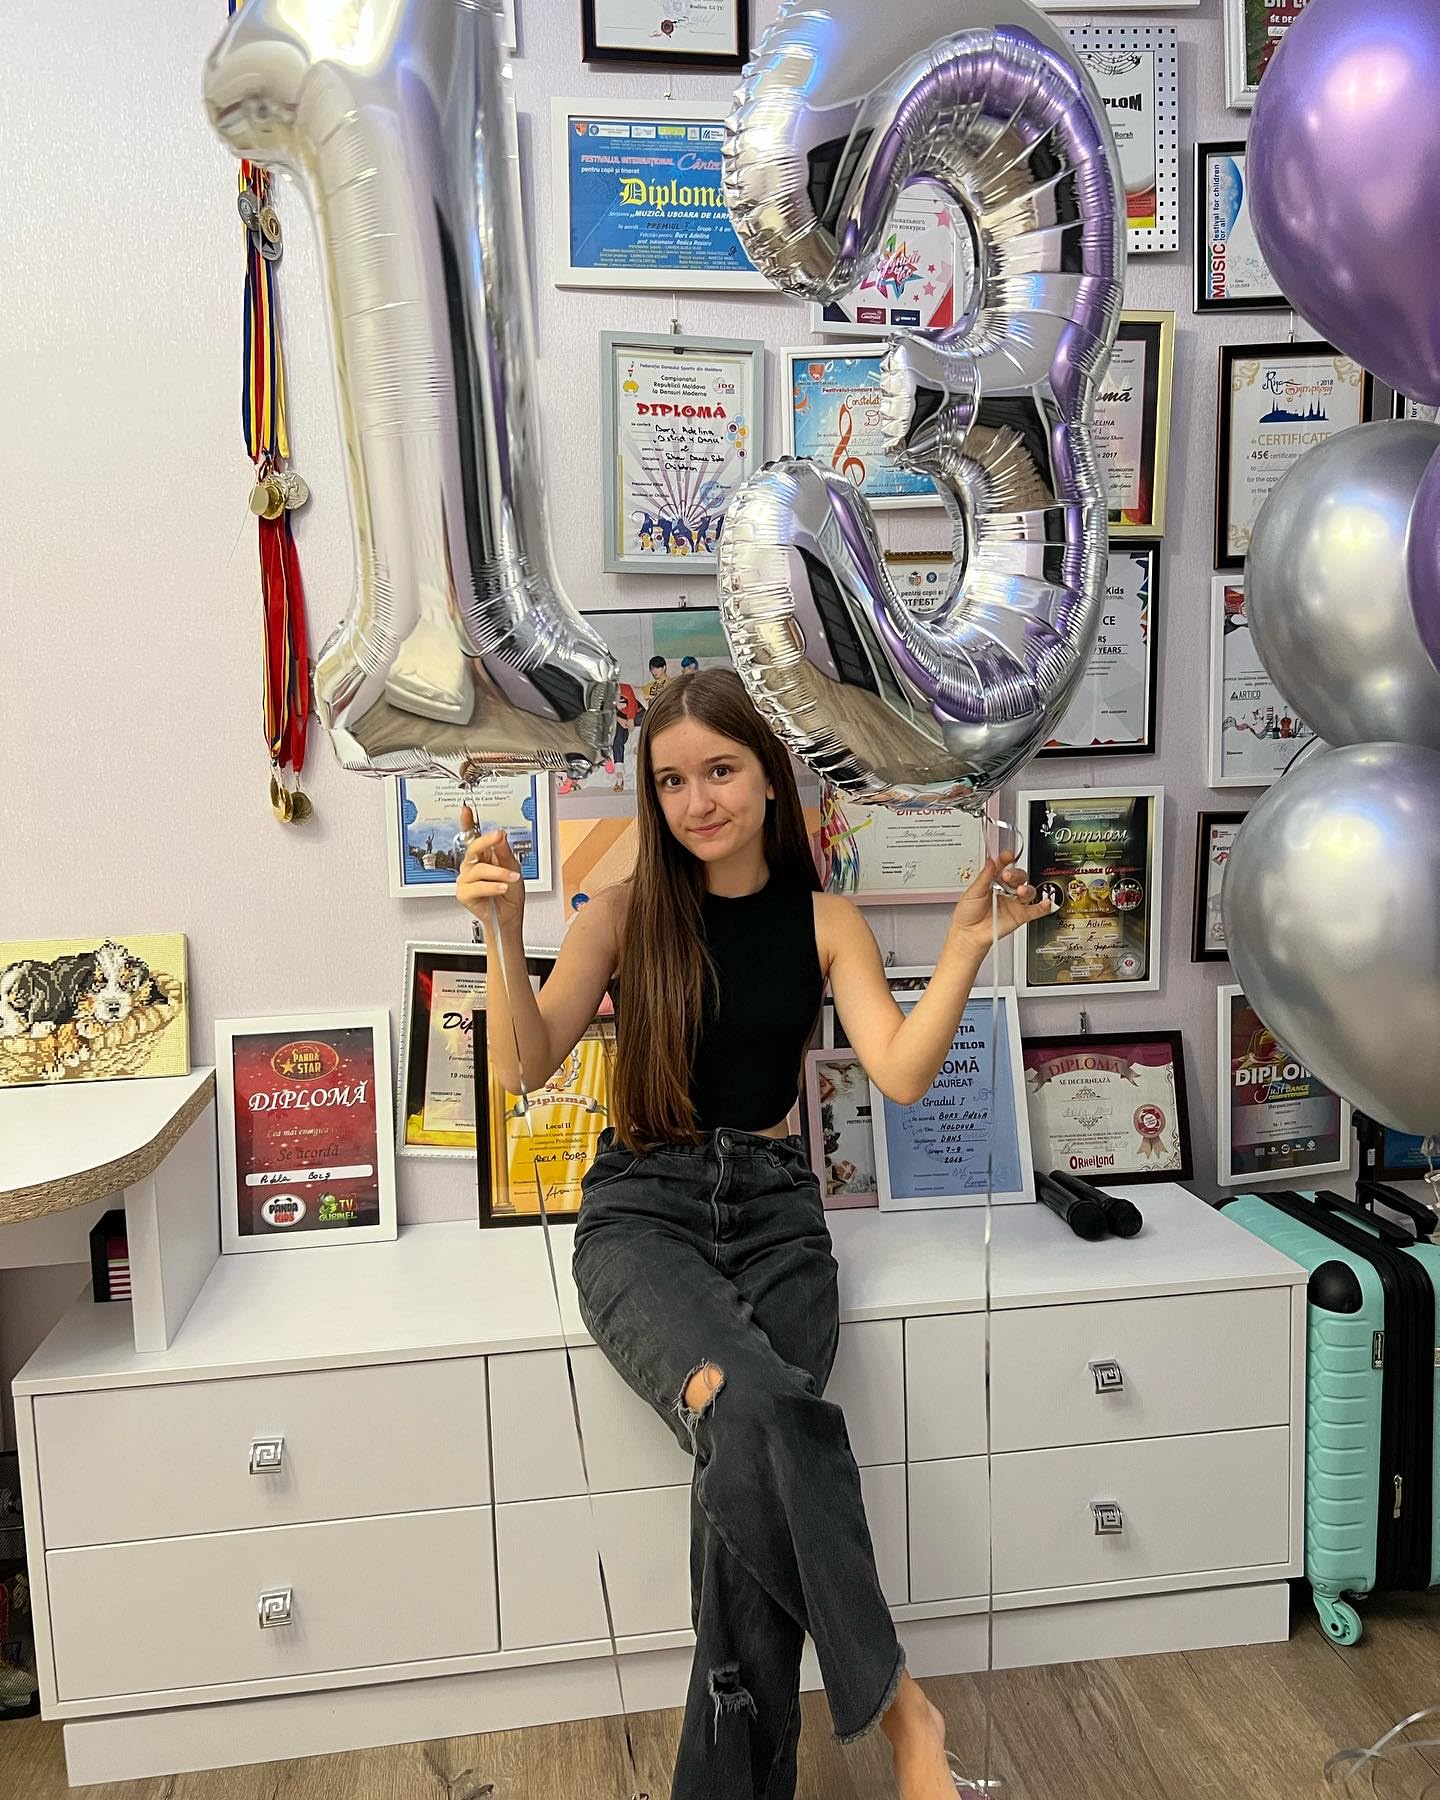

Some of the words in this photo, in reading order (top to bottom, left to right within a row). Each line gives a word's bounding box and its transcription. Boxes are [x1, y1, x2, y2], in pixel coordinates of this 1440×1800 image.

[1102, 93, 1142, 111] PLOM
[646, 222, 680, 230] PREMIUL
[1212, 243, 1226, 299] MUSIC
[653, 381, 681, 389] Republicii
[660, 375, 697, 383] Campionatul
[845, 394, 881, 410] Constelat
[1251, 450, 1269, 460] 45€
[1106, 586, 1125, 595] Kids
[1102, 615, 1116, 626] CE
[1098, 646, 1122, 654] YEARS
[1055, 827, 1129, 844] Диплом
[442, 1012, 473, 1034] Dip
[293, 1052, 320, 1063] PANDA
[297, 1062, 321, 1074] STAR
[932, 1078, 974, 1088] LAUREAT
[1285, 1084, 1310, 1092] DANCE
[248, 1080, 369, 1111] DIPLOMĂ
[922, 1095, 956, 1107] Gradul
[959, 1097, 966, 1106] I
[277, 1147, 293, 1161] Se
[296, 1142, 339, 1158] acordă
[269, 1202, 299, 1214] PANDA
[338, 1199, 354, 1212] TV
